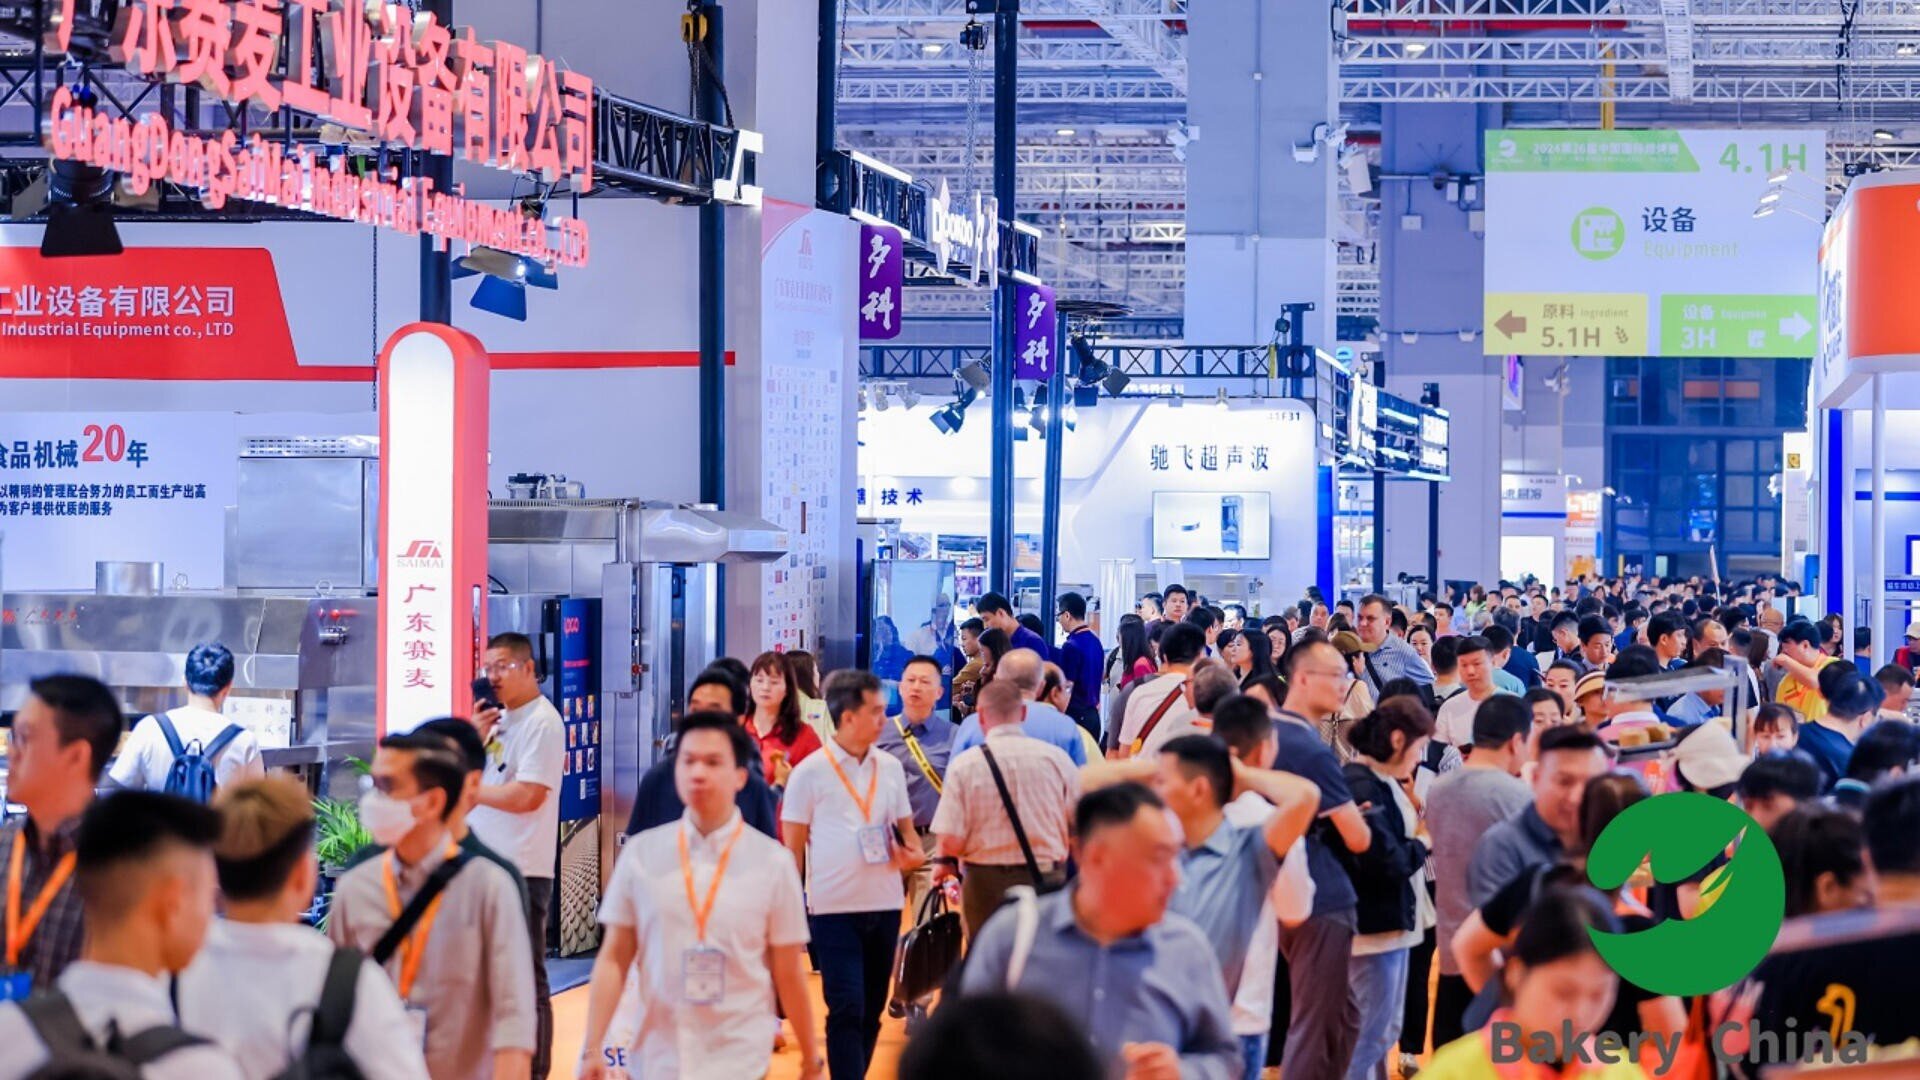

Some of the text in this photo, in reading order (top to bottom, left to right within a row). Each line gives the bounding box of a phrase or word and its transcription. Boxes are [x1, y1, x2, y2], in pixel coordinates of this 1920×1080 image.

[1719, 143, 1806, 173] 4.1H
[1642, 207, 1696, 232] 设备
[1644, 241, 1738, 259] Equipment
[1543, 303, 1574, 319] 原料
[2, 322, 79, 336] Industrial
[83, 322, 170, 339] Equipment
[206, 323, 234, 336] LTD
[1541, 326, 1600, 347] 5.1H
[1681, 326, 1717, 349] 3H
[1150, 444, 1269, 471] 驰飞超声波
[397, 559, 444, 568] SAIMAI
[403, 584, 436, 689] 广东赛麦
